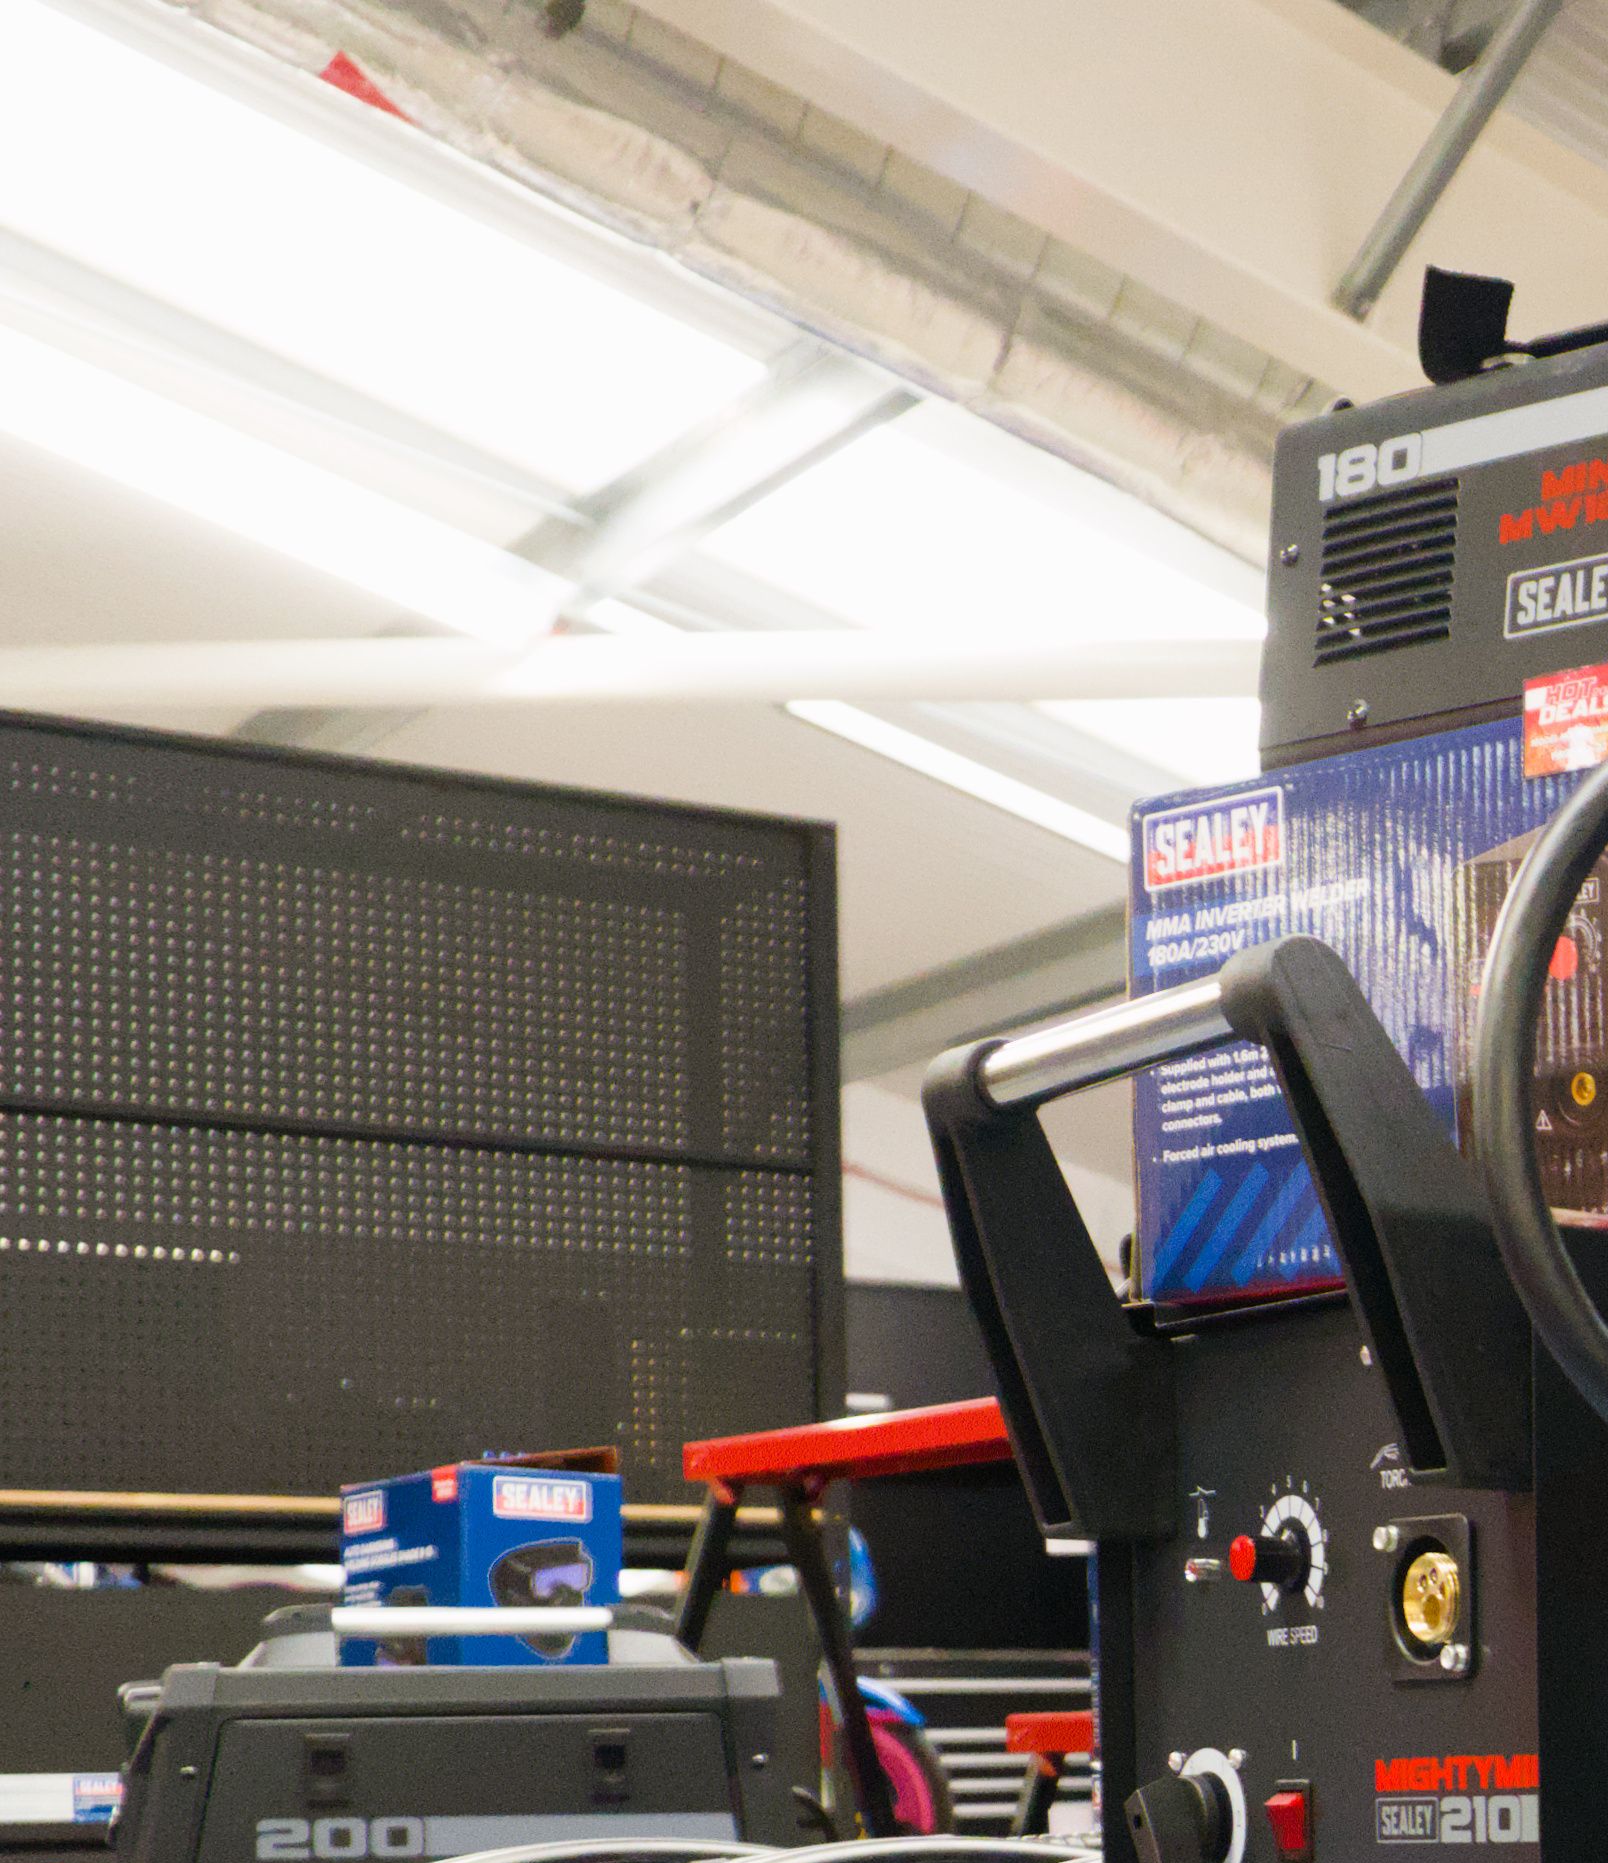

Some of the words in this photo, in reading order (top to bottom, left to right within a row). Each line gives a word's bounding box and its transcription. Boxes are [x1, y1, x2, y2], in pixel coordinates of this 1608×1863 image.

[1318, 432, 1423, 501] 180
[1547, 676, 1598, 704] HOT
[1156, 802, 1269, 878] SEALEY
[1146, 913, 1191, 941] MMA
[1195, 896, 1289, 932] INVERTER
[1291, 878, 1372, 910] WELDER
[1147, 929, 1245, 967] 180A/230V
[1160, 1057, 1206, 1076] Supplied
[1207, 1053, 1231, 1069] with
[1233, 1049, 1259, 1064] 1.6m
[1160, 1077, 1210, 1095] electrode
[1211, 1070, 1245, 1086] holder
[1247, 1066, 1267, 1080] and
[1161, 1098, 1193, 1114] clamp
[1195, 1094, 1215, 1107] and
[1217, 1089, 1249, 1105] cable,
[1250, 1083, 1275, 1099] both
[1161, 1113, 1223, 1132] connectors.
[1162, 1146, 1199, 1163] Forced
[1200, 1142, 1215, 1157] air
[1216, 1137, 1256, 1155] cooling
[1257, 1133, 1299, 1152] system.
[501, 1483, 579, 1513] SEALEY
[1267, 1628, 1289, 1646] WIRE
[1289, 1625, 1318, 1644] SPEED
[1381, 1805, 1434, 1837] SEALEY
[1441, 1794, 1520, 1843] 210
[256, 1817, 424, 1859] 200
